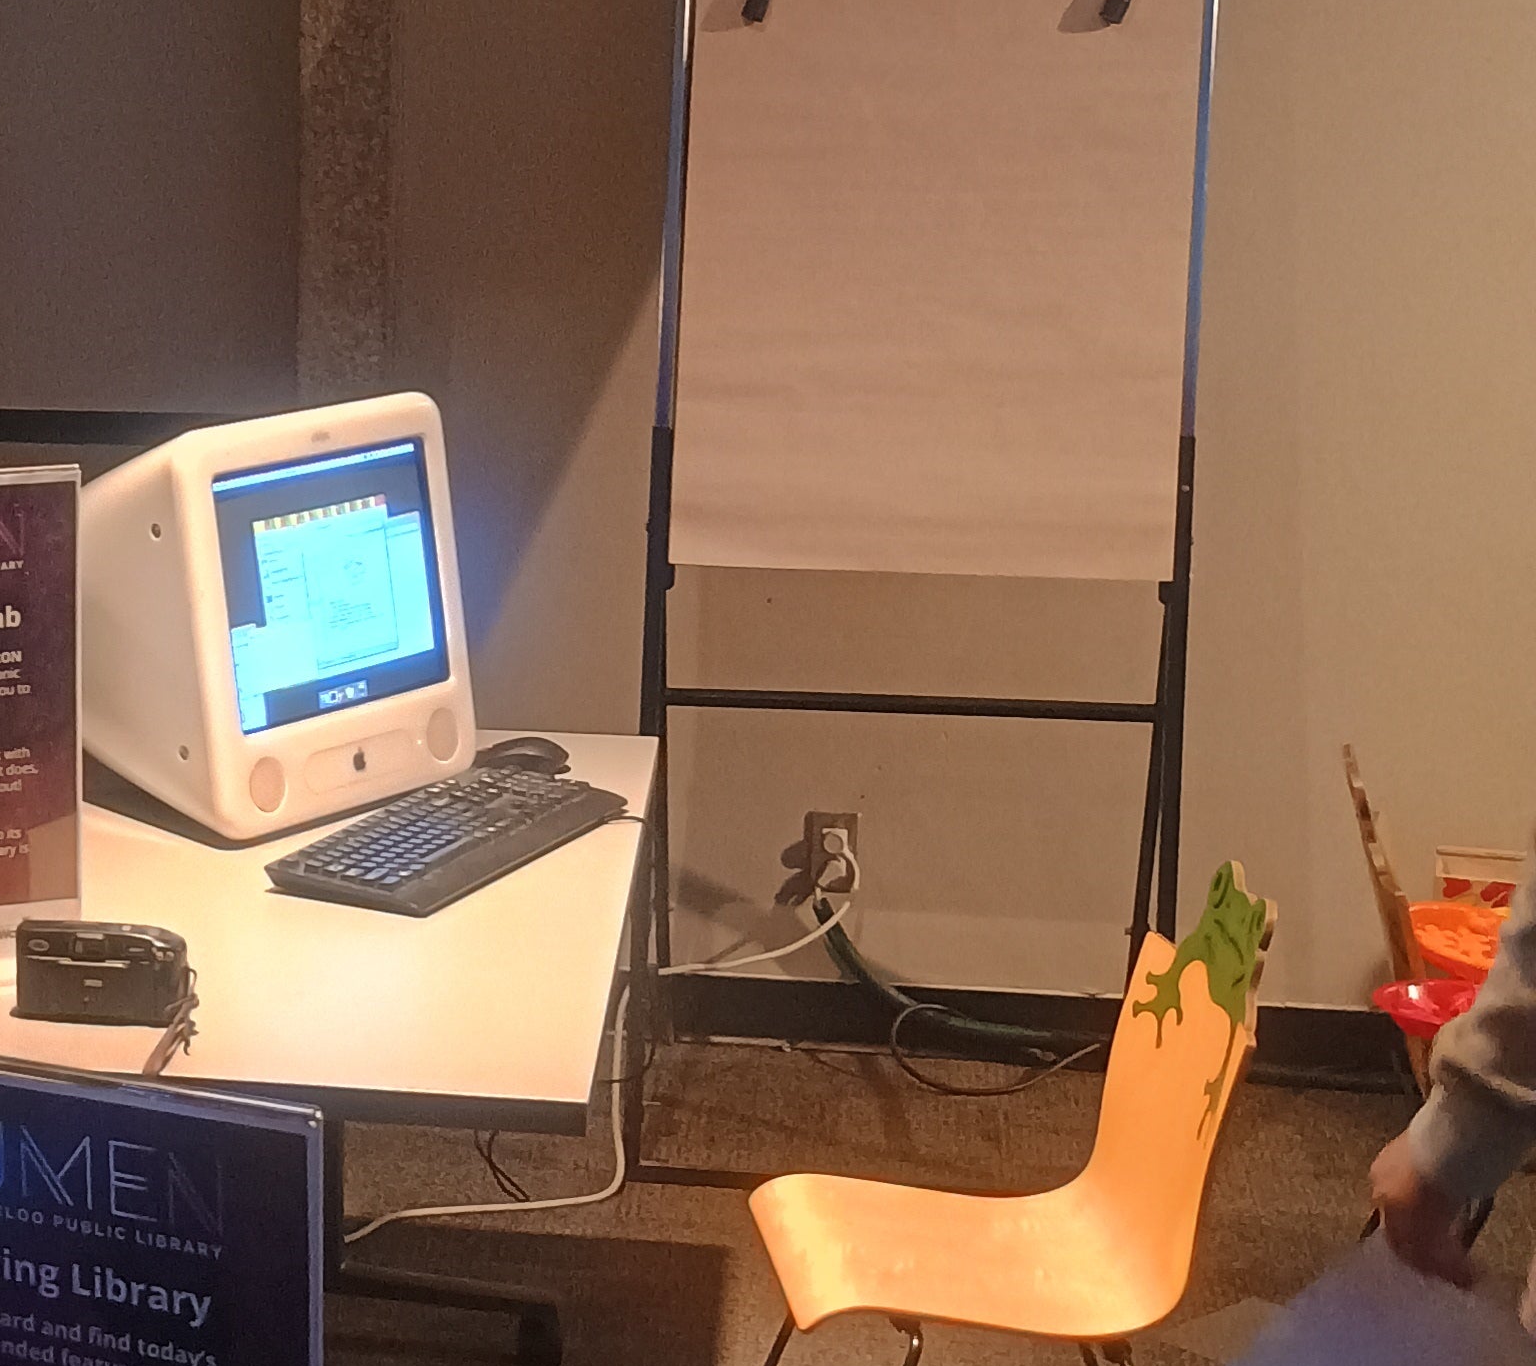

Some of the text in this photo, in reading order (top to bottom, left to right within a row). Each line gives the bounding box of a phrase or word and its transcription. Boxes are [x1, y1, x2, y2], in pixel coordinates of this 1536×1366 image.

[17, 684, 31, 695] to
[3, 746, 31, 760] with
[6, 828, 22, 840] its
[18, 843, 30, 855] is
[52, 1214, 126, 1241] PUBLIC
[135, 1229, 223, 1261] LIBRARY
[71, 1263, 212, 1328] Library
[41, 1318, 81, 1343] and
[88, 1325, 131, 1352] find
